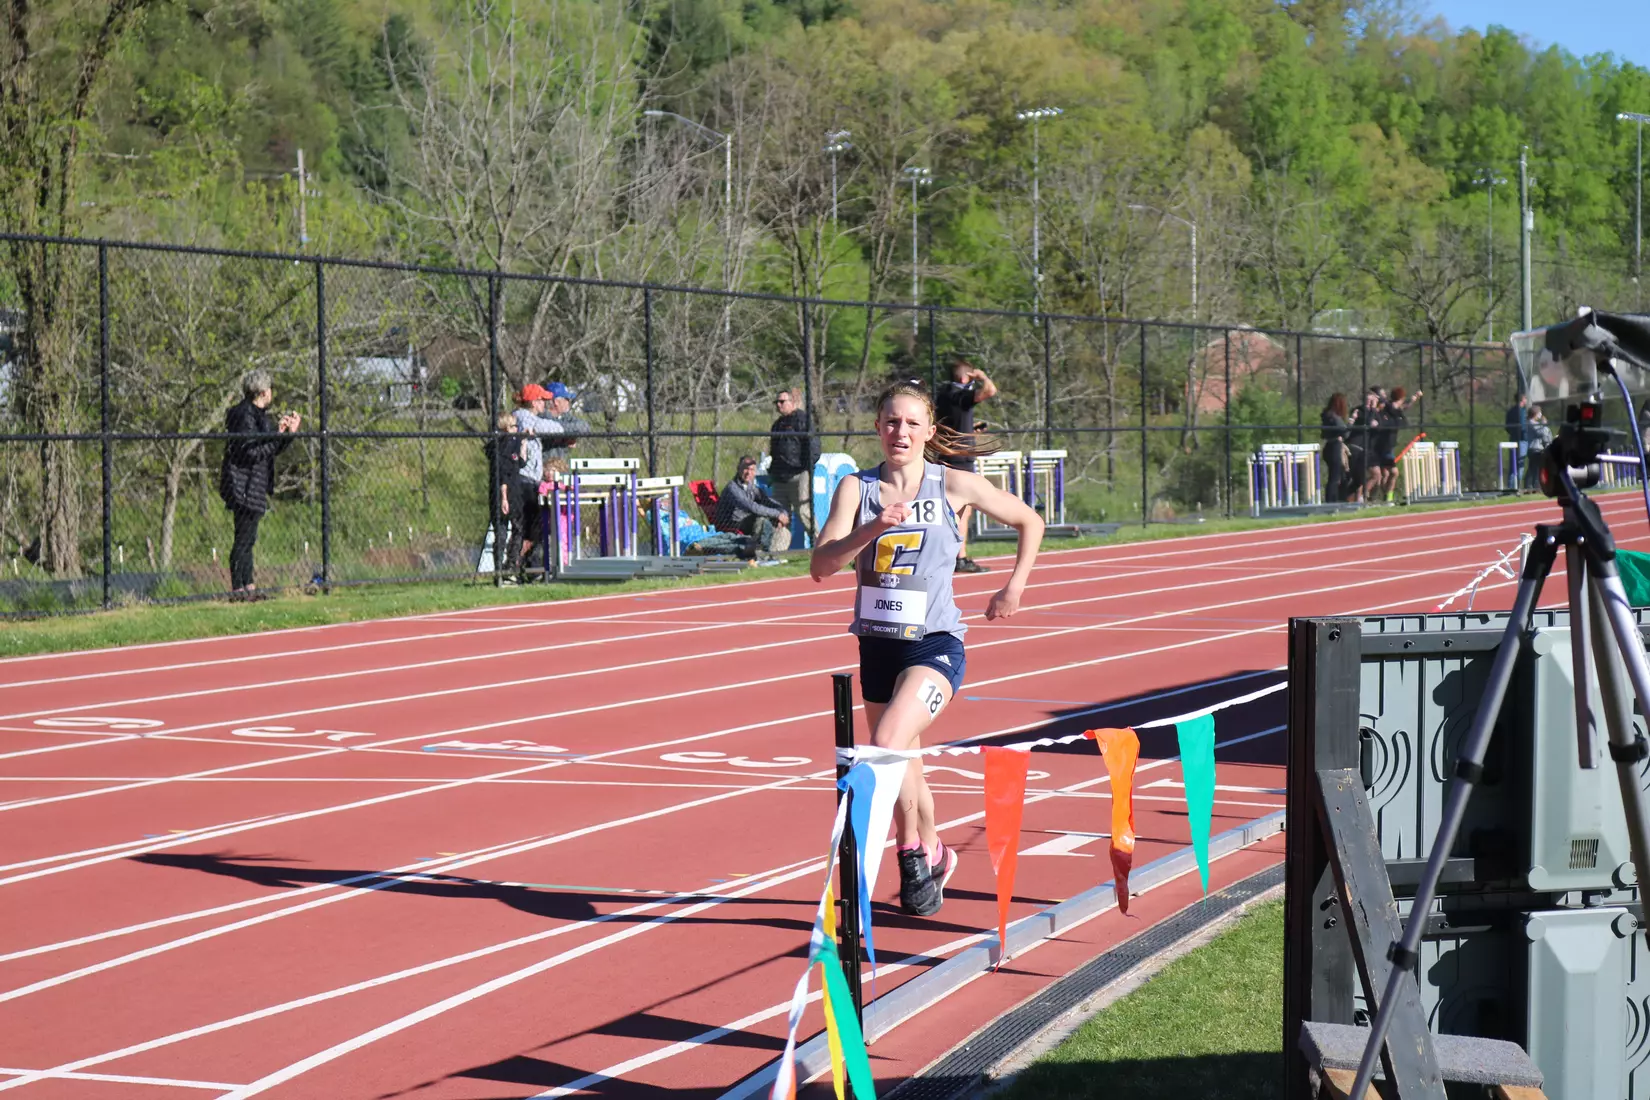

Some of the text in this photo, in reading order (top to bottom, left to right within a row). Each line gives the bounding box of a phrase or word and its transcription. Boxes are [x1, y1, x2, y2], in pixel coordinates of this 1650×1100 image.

[911, 499, 936, 523] 18
[874, 599, 903, 612] JONES
[925, 684, 943, 714] 18
[659, 751, 812, 768] 3
